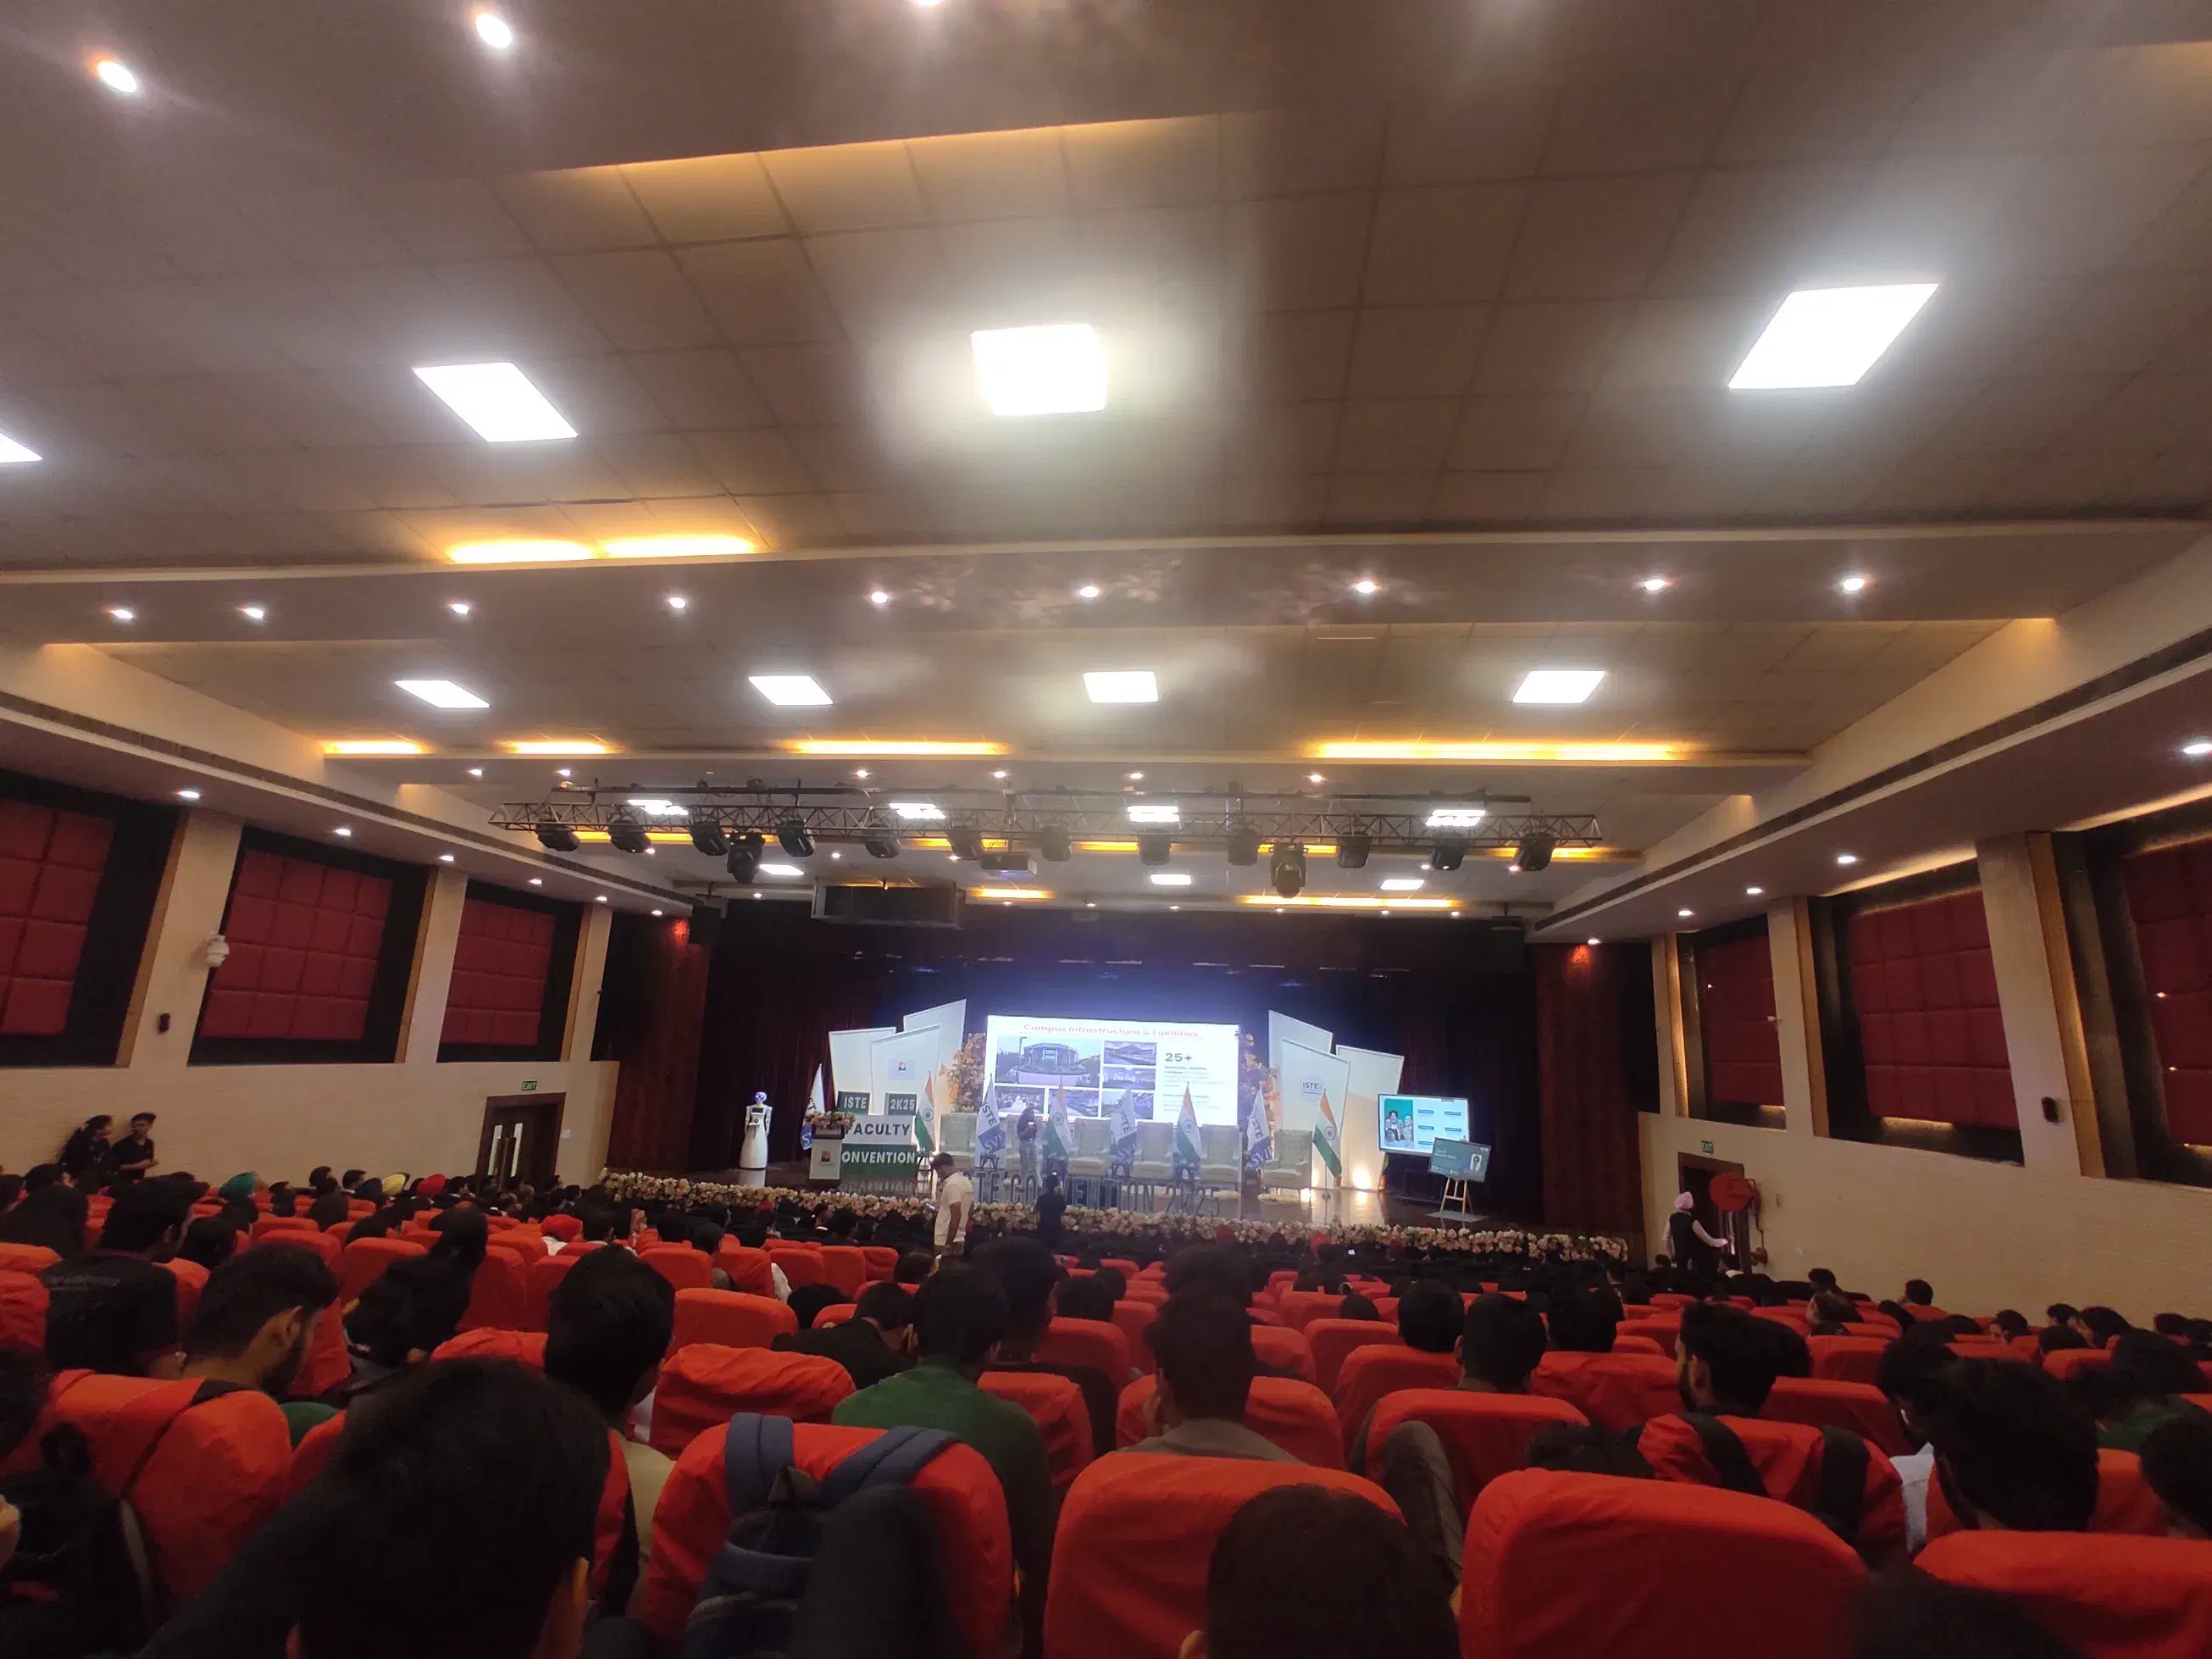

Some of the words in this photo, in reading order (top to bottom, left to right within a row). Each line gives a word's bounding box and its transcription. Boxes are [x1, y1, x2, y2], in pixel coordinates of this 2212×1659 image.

[1023, 1024, 1067, 1034] Campus
[1068, 1026, 1141, 1035] Infrastructure
[1164, 1052, 1193, 1063] 25+
[1302, 1081, 1319, 1090] ISTE
[844, 1096, 867, 1109] ISTE
[890, 1098, 915, 1111] 2K25
[847, 1123, 911, 1136] ACULTY
[841, 1150, 916, 1164] ONVENTION
